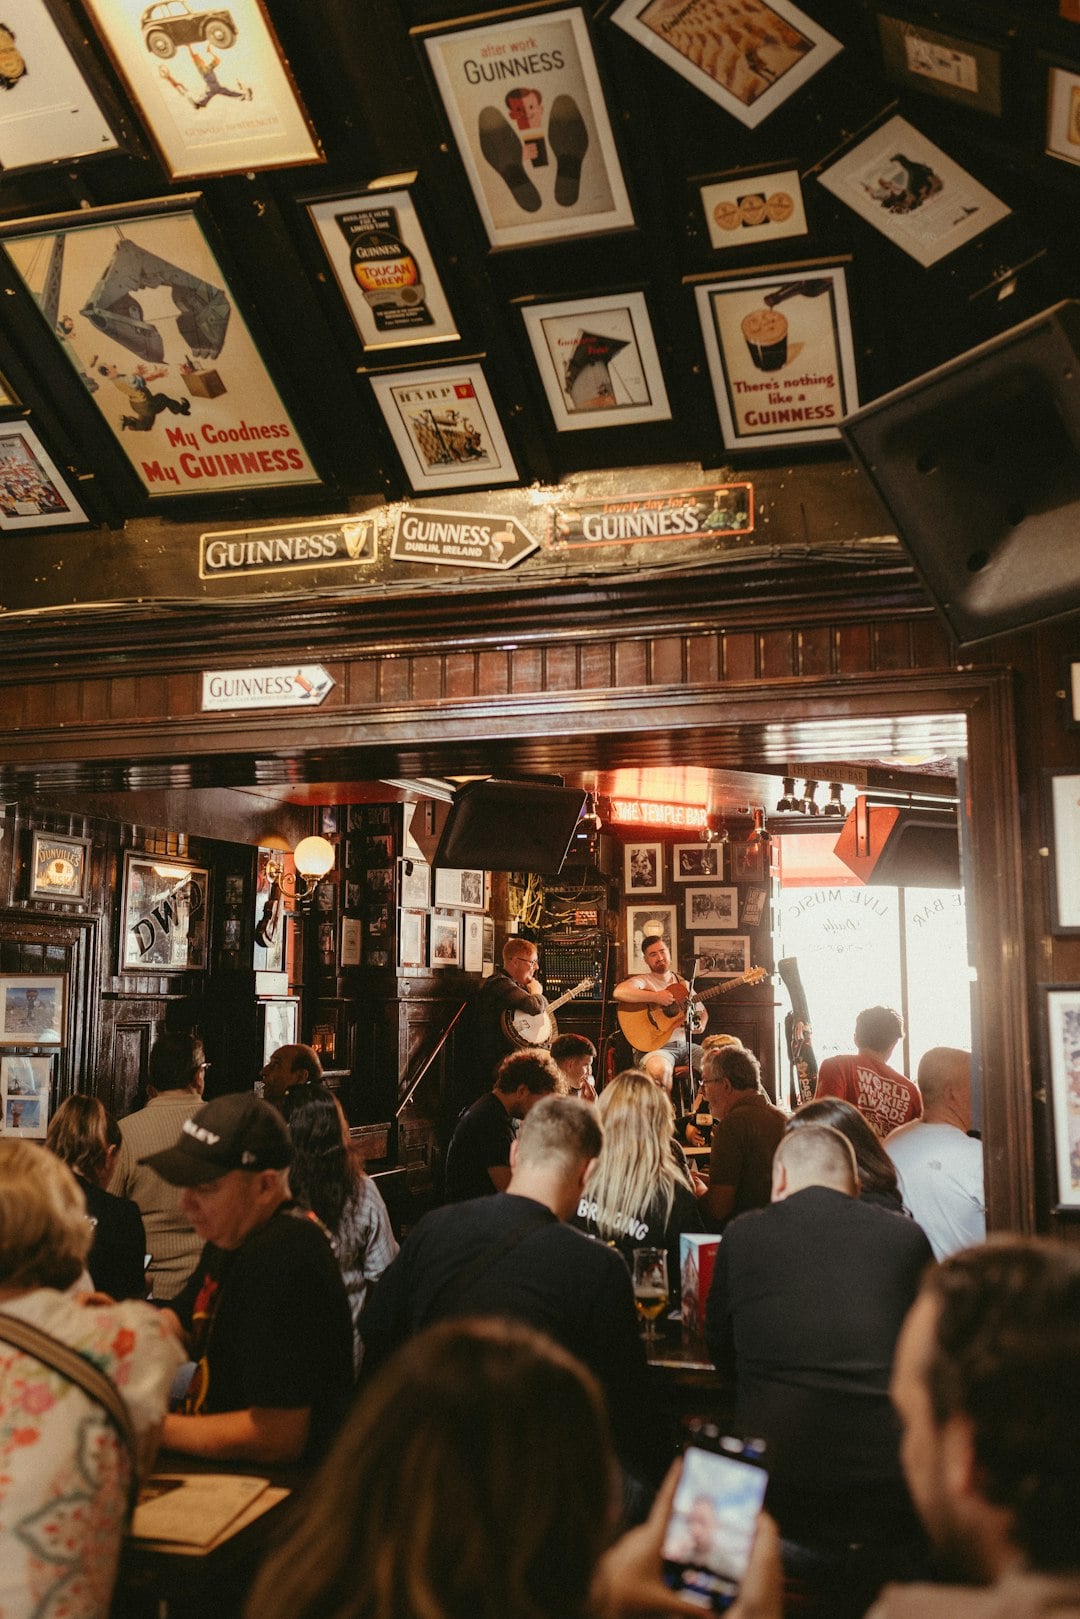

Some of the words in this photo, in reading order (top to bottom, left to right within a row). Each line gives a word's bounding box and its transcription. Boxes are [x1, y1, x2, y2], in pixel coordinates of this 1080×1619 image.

[480, 44, 507, 58] after
[509, 37, 538, 54] work
[463, 50, 565, 85] GUINNESS
[356, 244, 402, 259] GUINNESS
[361, 263, 412, 279] TOUCAN
[375, 275, 405, 286] BREW
[733, 379, 780, 393] There's
[783, 373, 835, 388] nothing
[768, 393, 793, 405] like
[798, 394, 806, 402] a
[744, 404, 836, 427] GUINNESS
[165, 427, 200, 451] My
[201, 420, 291, 446] Goodness
[141, 461, 181, 485] My
[181, 448, 304, 479] GUINNESS
[603, 501, 641, 514] Lovely
[643, 498, 666, 512] day
[668, 496, 687, 507] for
[402, 517, 491, 546] GUINNESS
[582, 508, 699, 542] GUINNESS
[205, 533, 337, 569] GUINNESS
[404, 541, 441, 554] DUBLIN,
[443, 544, 483, 557] IRELAND
[209, 675, 293, 698] GUINNESS
[793, 764, 809, 775] THE
[813, 766, 845, 779] TEMPLE
[848, 770, 864, 782] BAR
[615, 801, 638, 820] THE
[640, 802, 683, 824] TEMPLE
[685, 807, 708, 827] BAR
[857, 1069, 911, 1102] WORLD
[858, 1081, 910, 1112] WHISKIES
[857, 1093, 906, 1123] AWARDS
